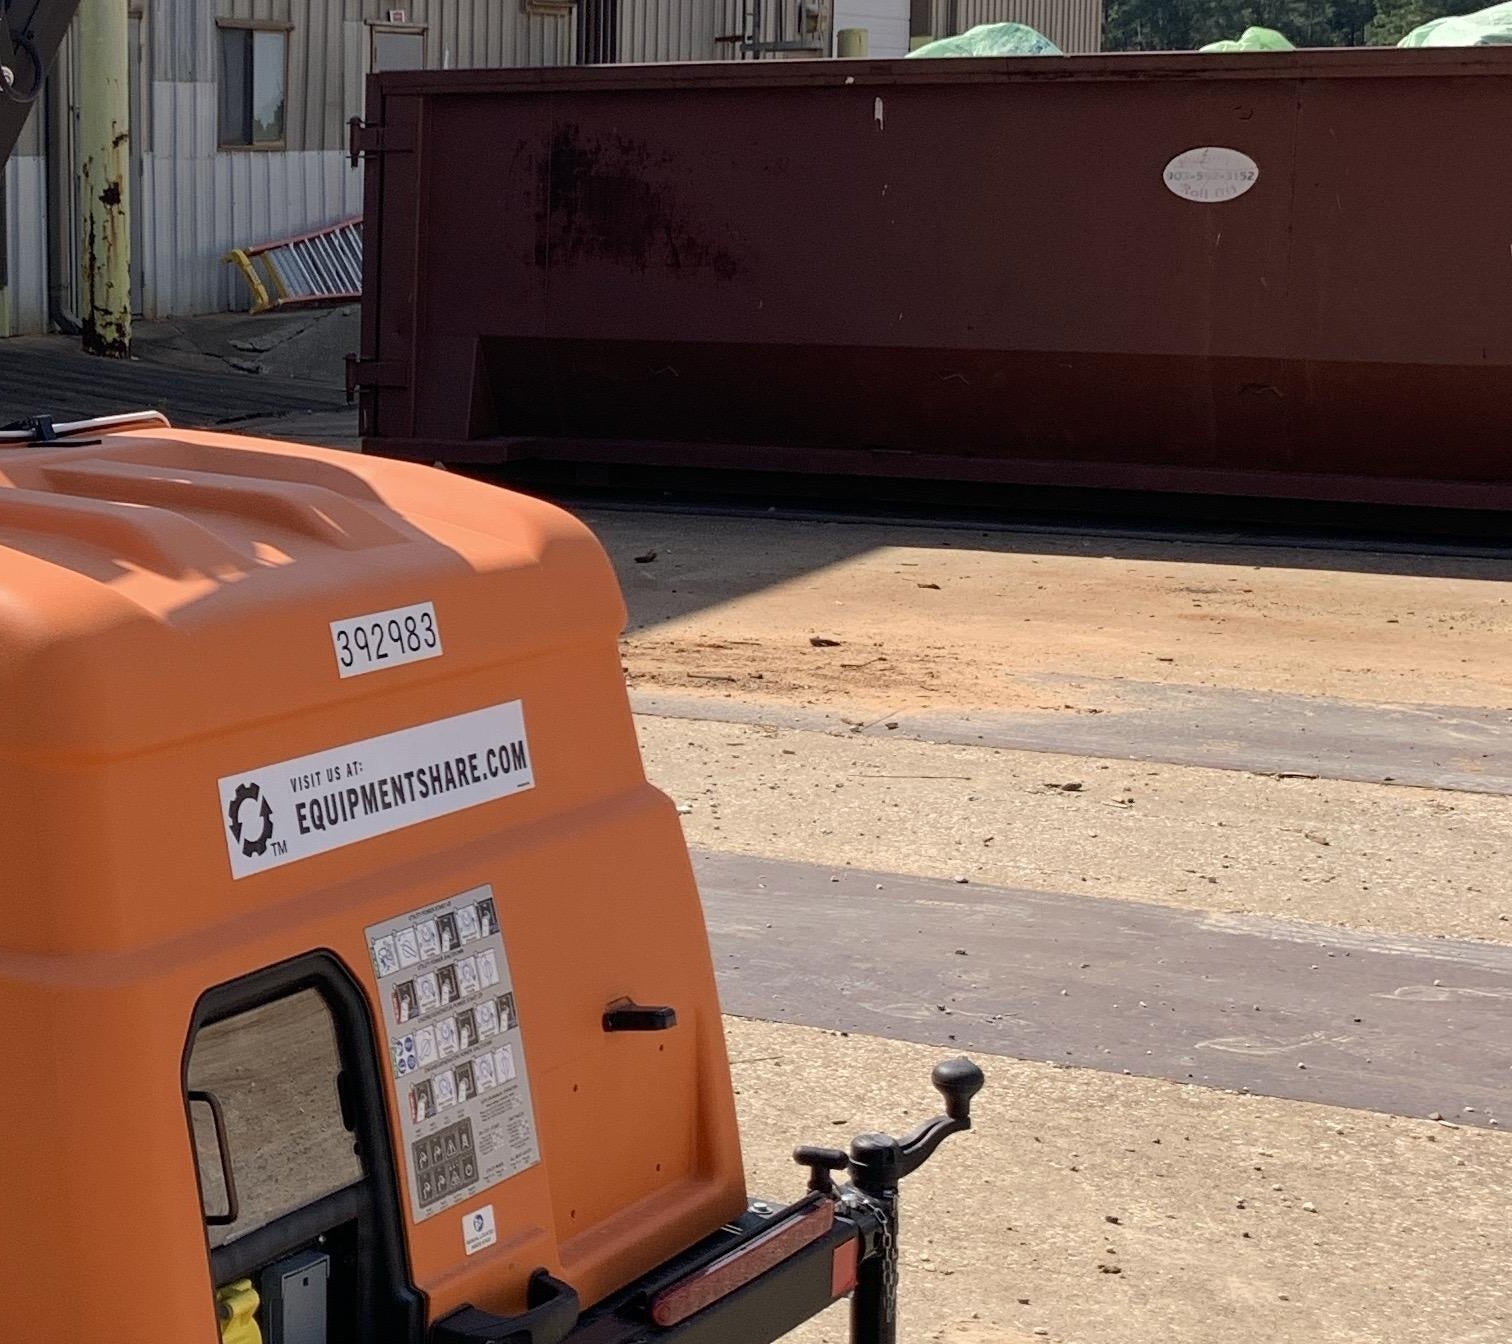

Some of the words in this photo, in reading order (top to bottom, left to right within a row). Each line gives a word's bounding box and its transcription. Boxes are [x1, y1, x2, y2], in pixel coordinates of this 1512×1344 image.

[336, 613, 437, 667] 392983
[289, 771, 322, 794] VISIT
[326, 766, 342, 783] US
[345, 760, 364, 778] AT:
[295, 739, 528, 836] EQUIPMENTSHARE.COM
